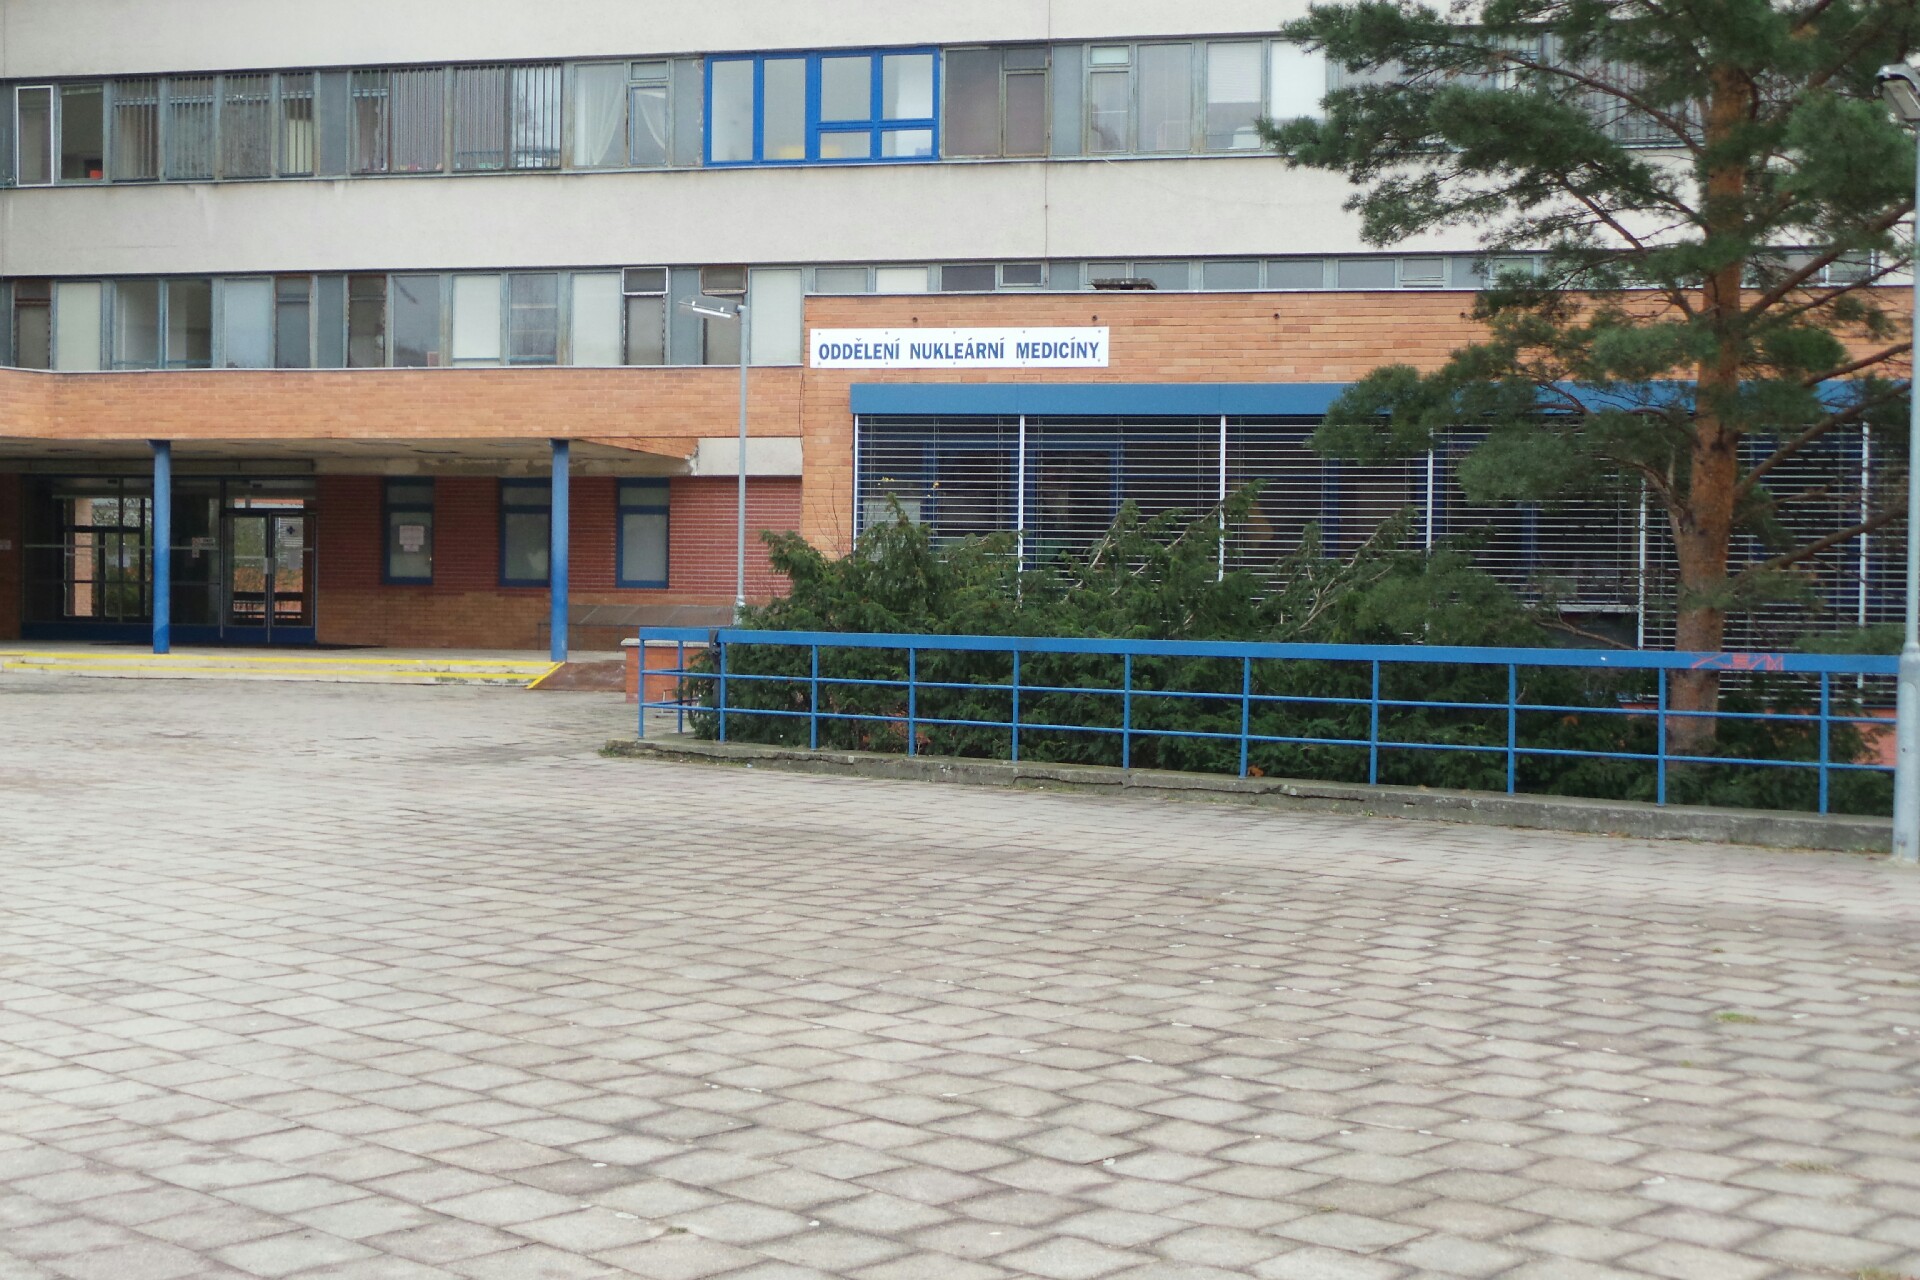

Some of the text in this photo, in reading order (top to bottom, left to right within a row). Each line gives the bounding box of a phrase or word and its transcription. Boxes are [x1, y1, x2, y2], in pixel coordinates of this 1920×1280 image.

[818, 336, 1100, 361] ODDĚLENÍ NUKLEÁRNÍ MEDICÍNY
